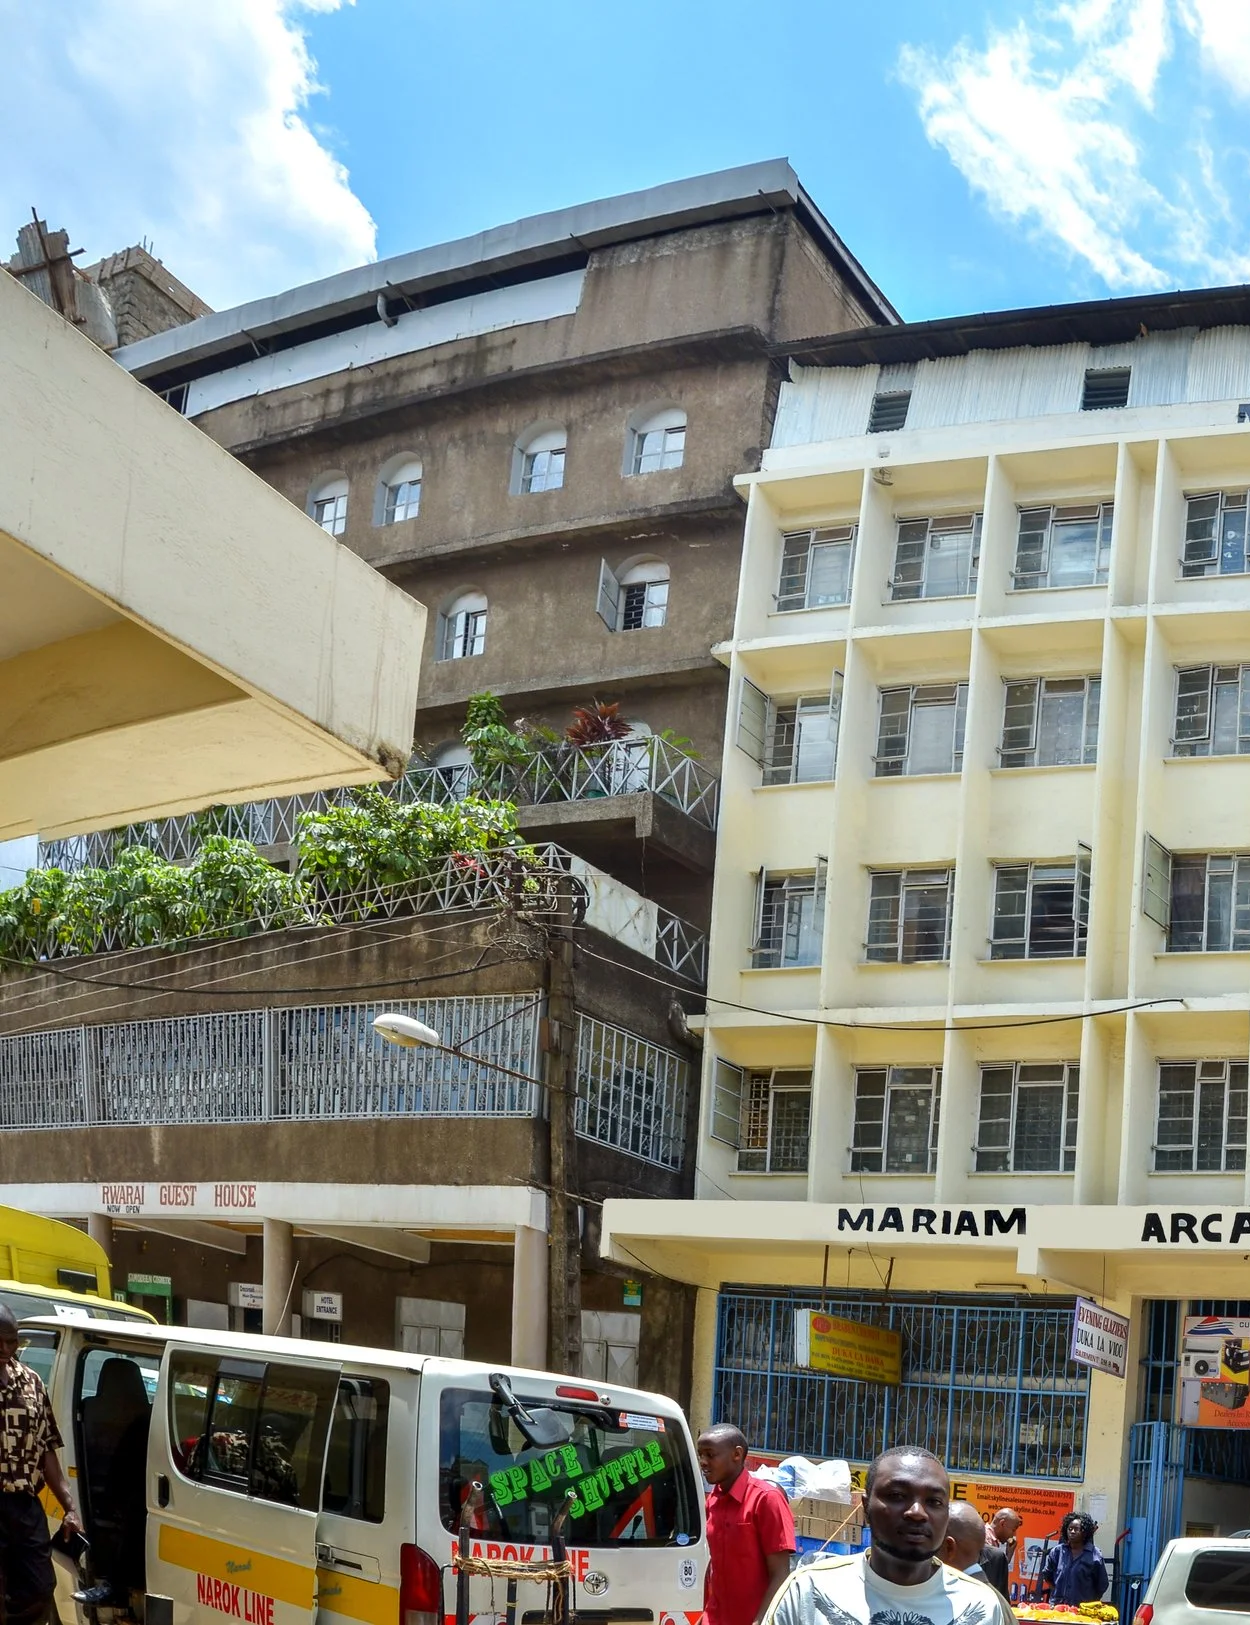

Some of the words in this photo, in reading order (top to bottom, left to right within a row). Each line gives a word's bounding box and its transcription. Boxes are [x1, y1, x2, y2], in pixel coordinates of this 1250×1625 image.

[102, 1185, 145, 1205] RWARAI
[159, 1185, 197, 1206] GUEST
[214, 1184, 257, 1208] HOUSE
[106, 1204, 121, 1214] NOW
[126, 1205, 141, 1214] OPEN
[837, 1206, 1028, 1237] MARIAM
[316, 1305, 338, 1315] ENTRANCE
[321, 1296, 333, 1305] HOTEL
[1078, 1306, 1103, 1330] EVENING
[1103, 1316, 1127, 1340] GLAZIERS
[1077, 1328, 1093, 1349] DUKA
[1097, 1335, 1105, 1352] LA
[489, 1442, 584, 1507] SPACE
[564, 1440, 666, 1520] SHUTTLE
[684, 1566, 693, 1576] 80
[197, 1573, 241, 1618] NAROK
[244, 1589, 275, 1625] LINE
